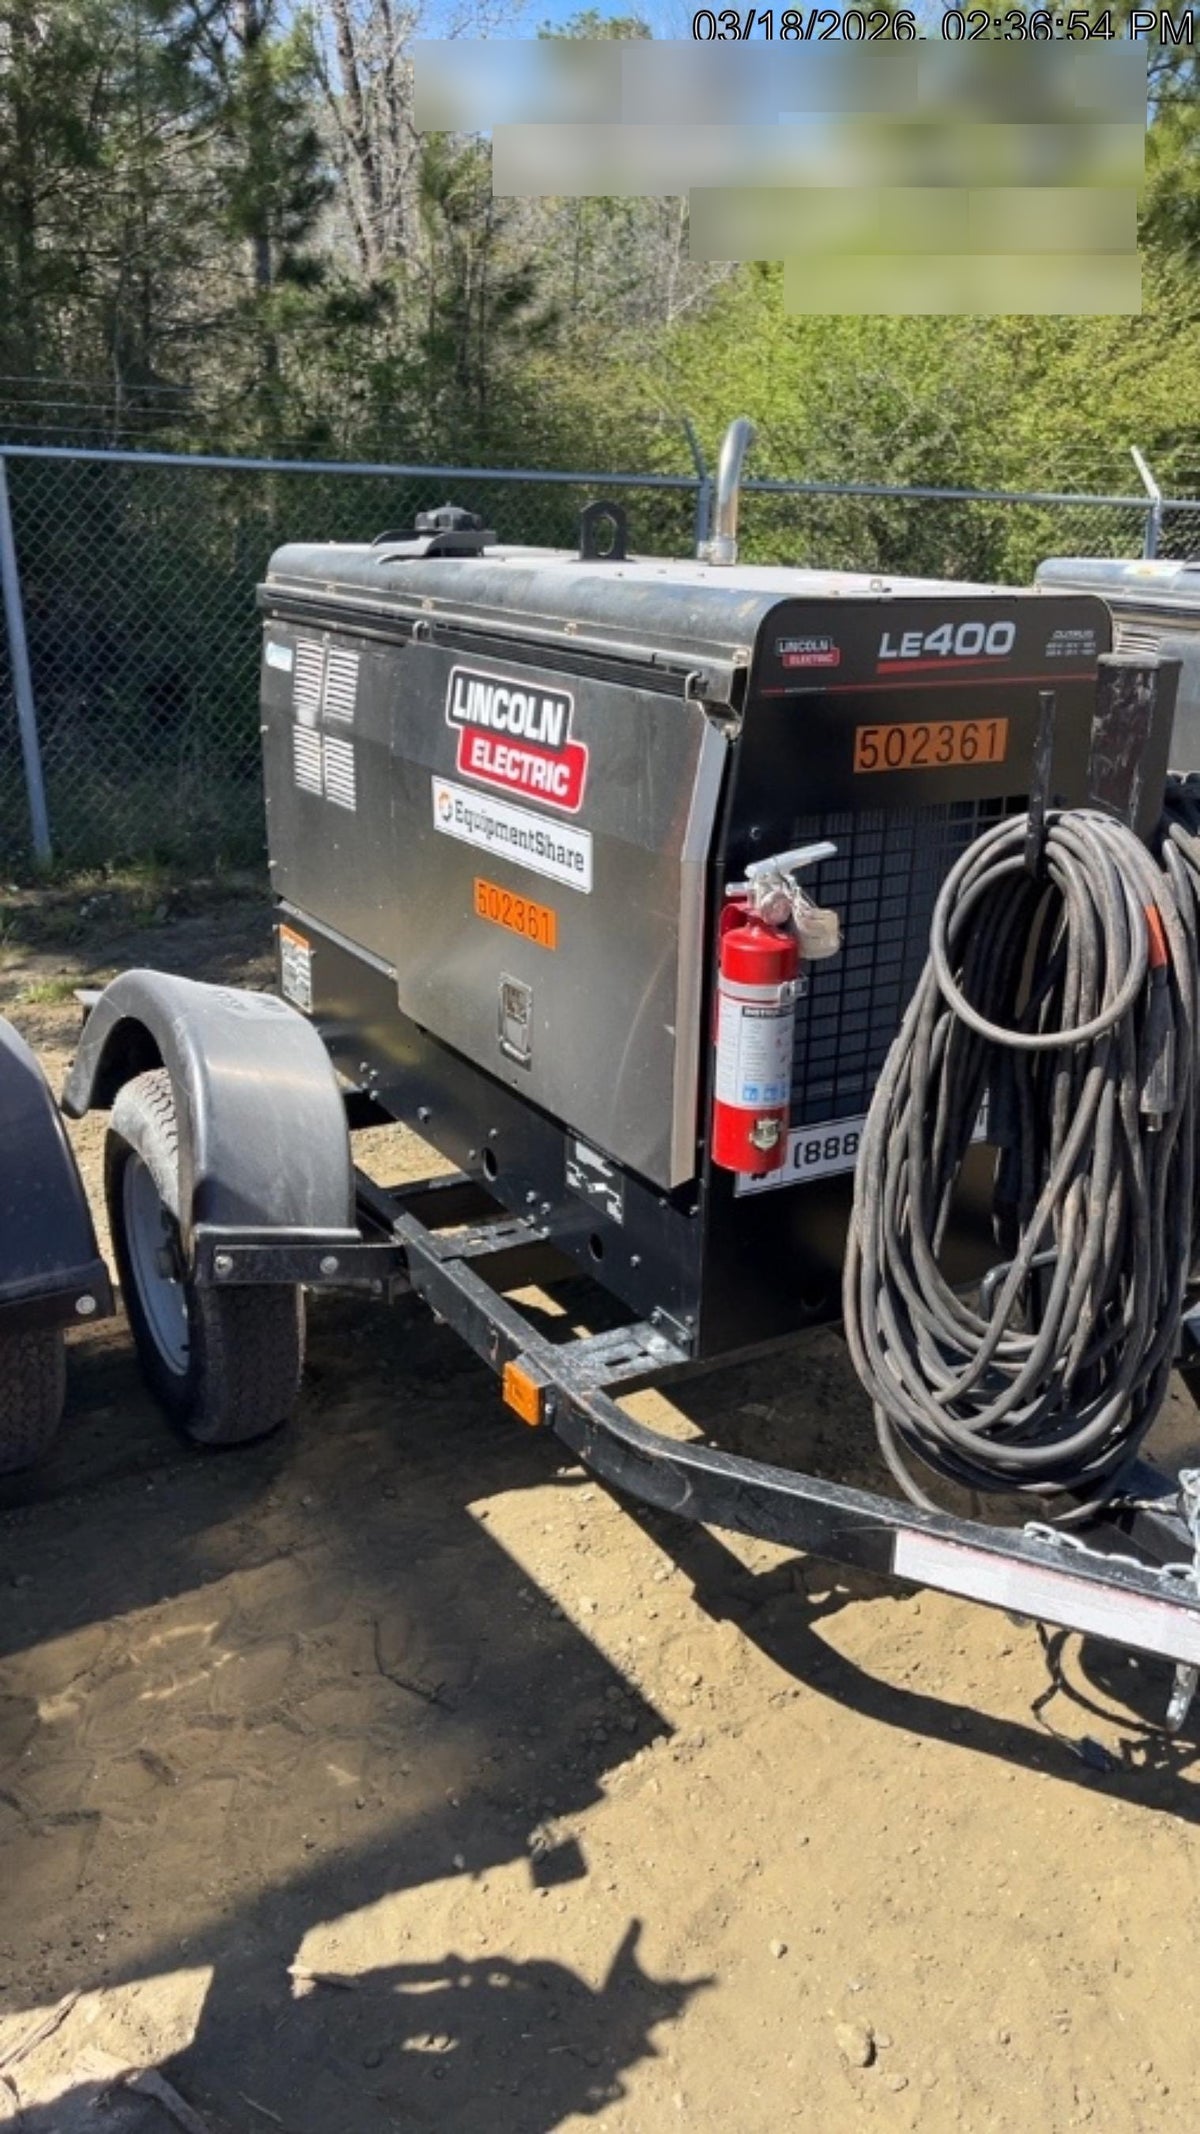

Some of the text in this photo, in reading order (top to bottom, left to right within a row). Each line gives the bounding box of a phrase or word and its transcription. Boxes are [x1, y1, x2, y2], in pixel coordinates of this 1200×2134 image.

[878, 621, 1016, 658] LE400
[452, 677, 565, 746] LINCOLN
[470, 737, 571, 797] ELECTRIC
[859, 723, 998, 769] 502361
[455, 799, 585, 872] EquipmentShare
[478, 882, 549, 945] 502361
[794, 1128, 863, 1169] (888
